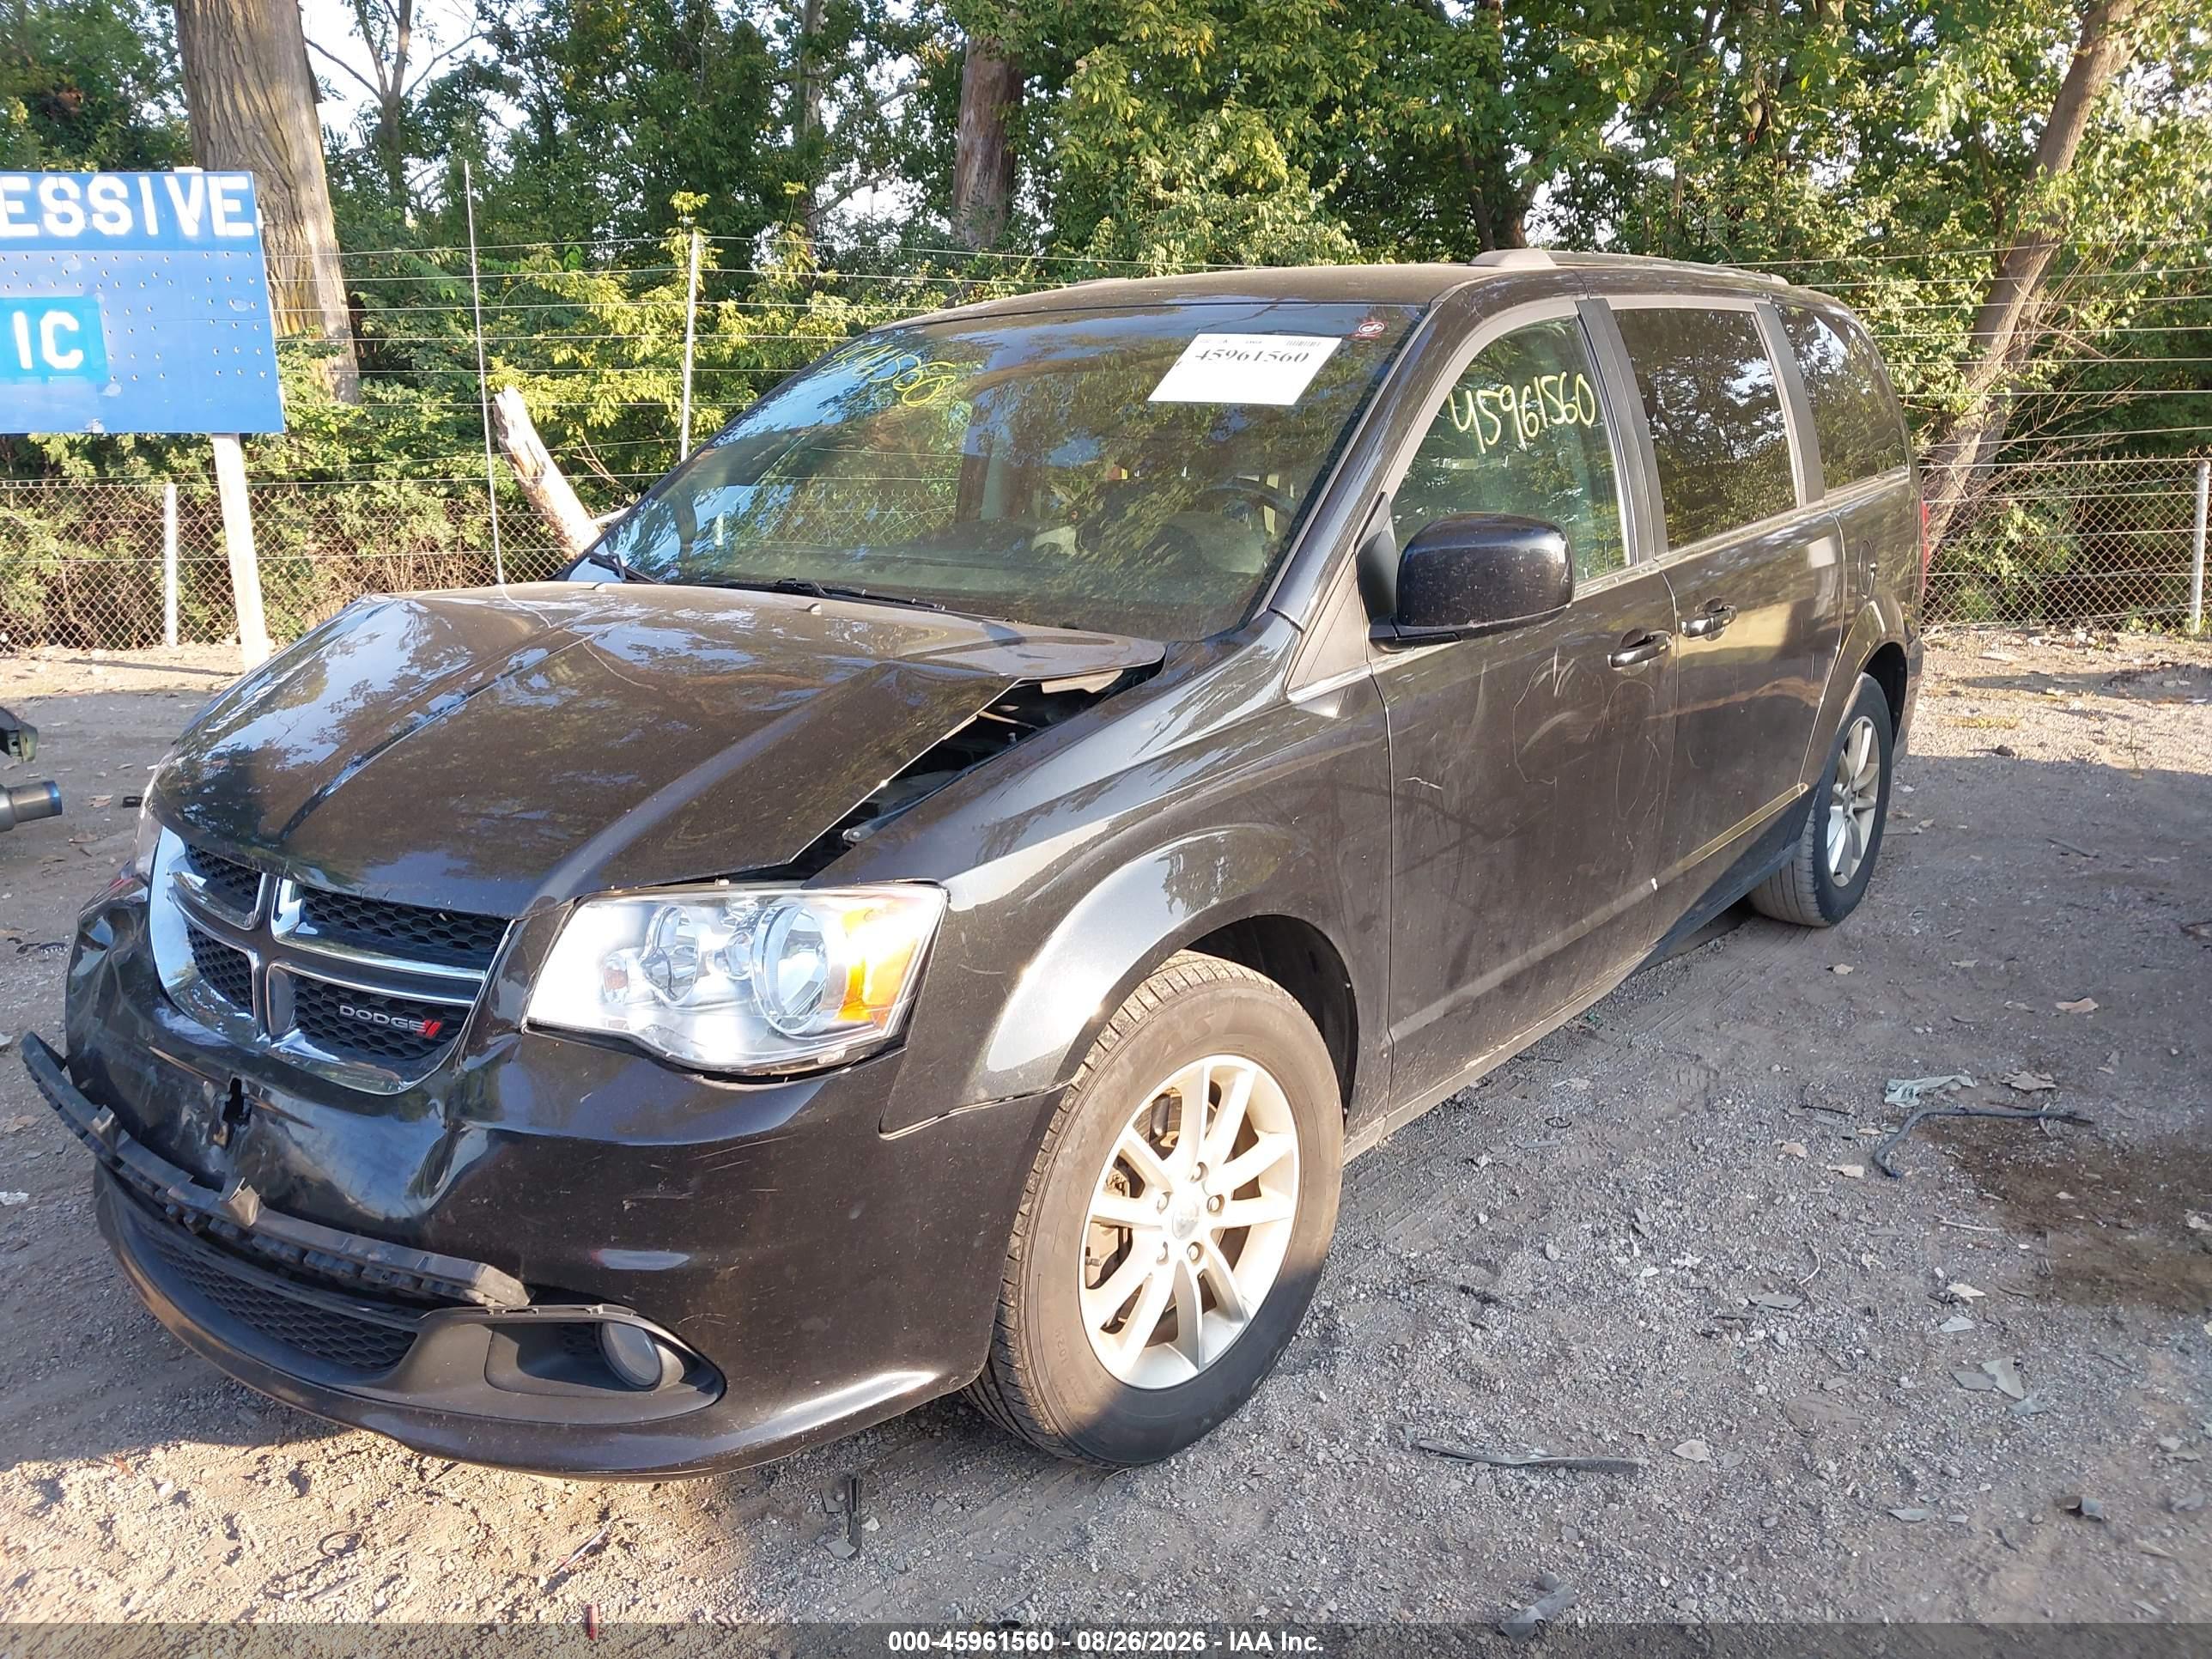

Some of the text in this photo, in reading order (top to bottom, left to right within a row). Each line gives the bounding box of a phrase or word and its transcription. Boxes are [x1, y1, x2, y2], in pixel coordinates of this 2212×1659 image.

[0, 176, 254, 237] ESSIVE
[12, 310, 84, 370] IC
[1195, 349, 1310, 363] 45961560
[1448, 371, 1596, 454] 45961560
[339, 1005, 427, 1032] DODGE
